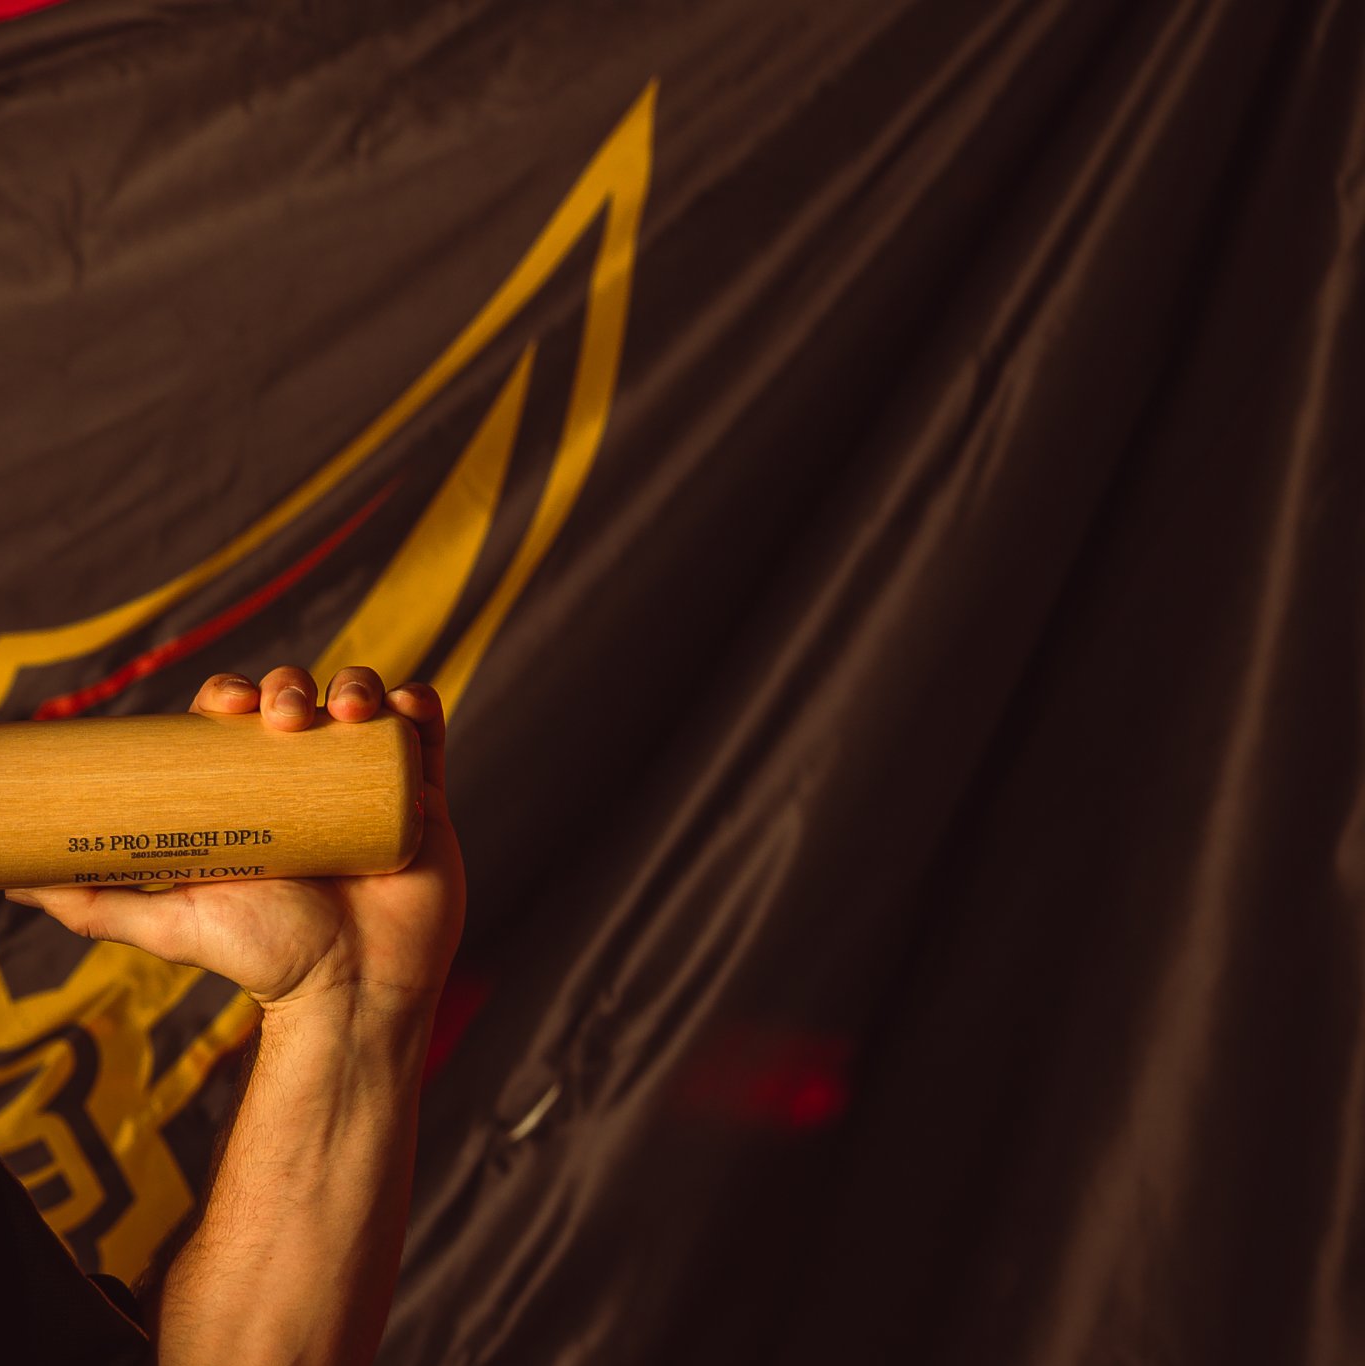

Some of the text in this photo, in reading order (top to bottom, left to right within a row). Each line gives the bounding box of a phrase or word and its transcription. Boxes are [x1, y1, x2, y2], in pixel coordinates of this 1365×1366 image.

[68, 829, 273, 853] 33.5 PRO BIRCH DP15
[75, 866, 265, 883] BRANDON LOWE
